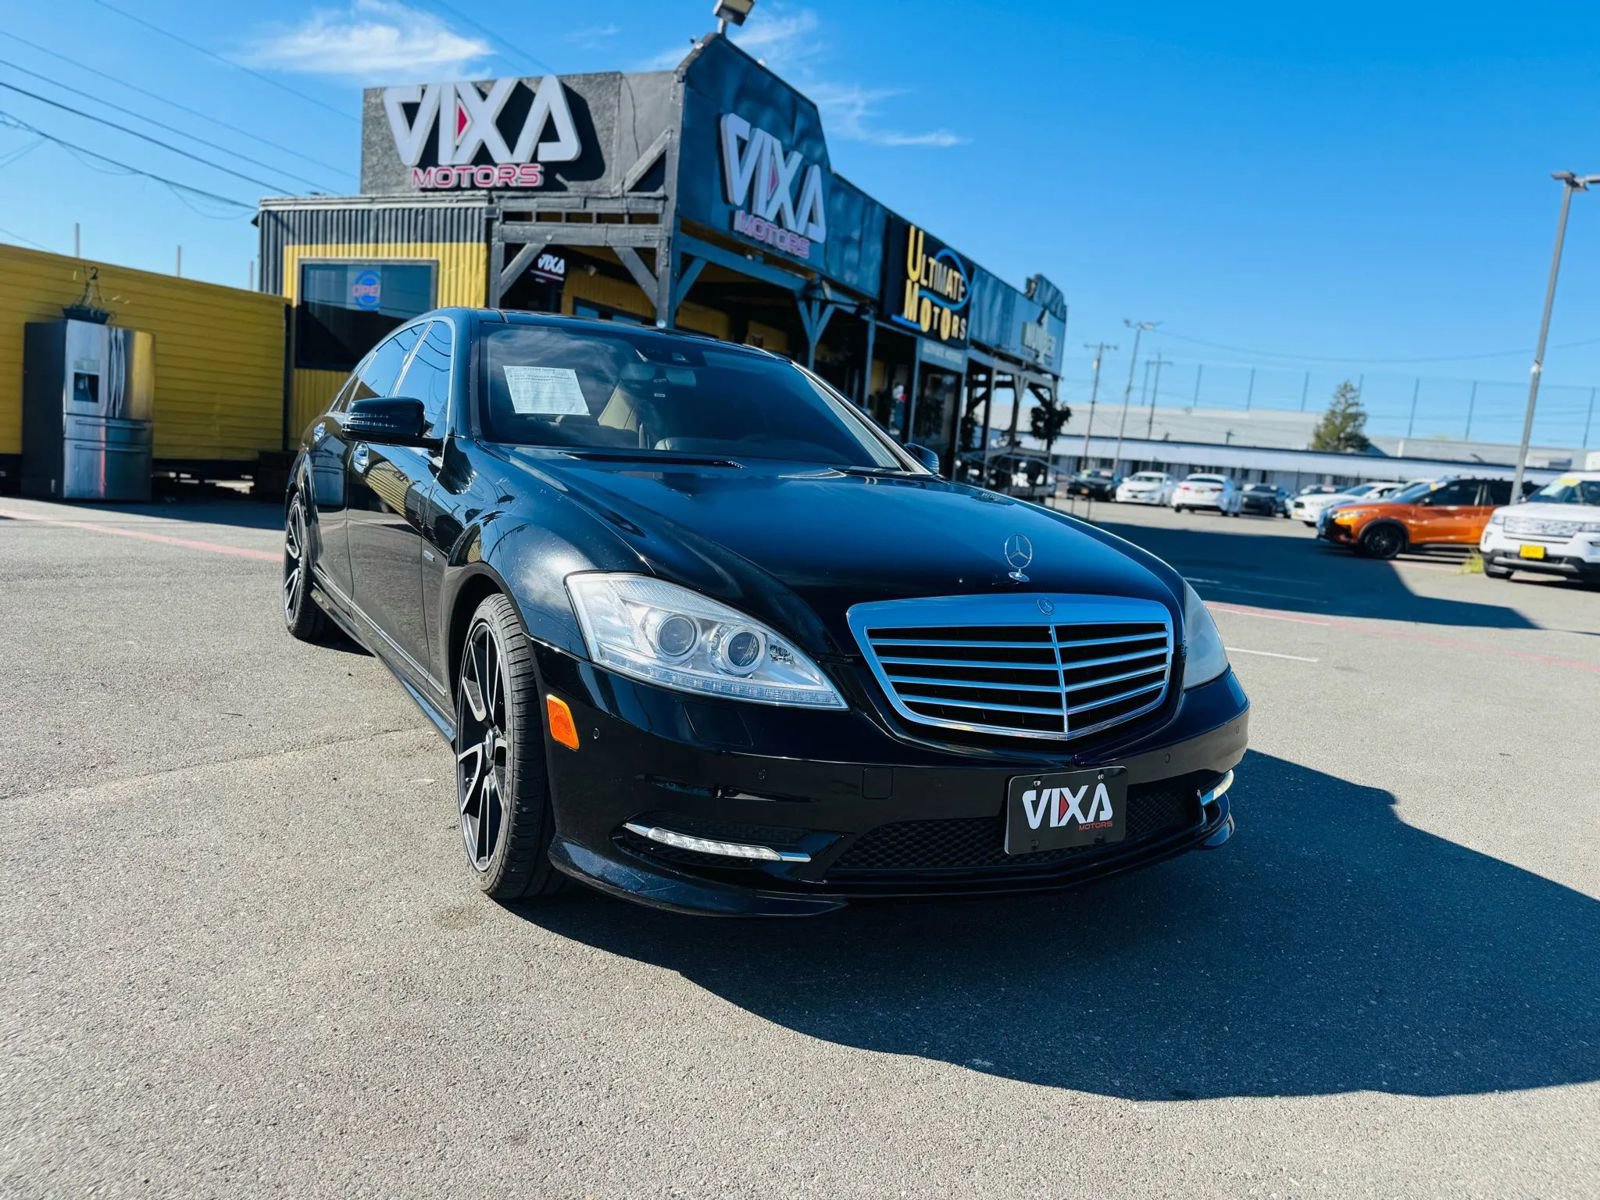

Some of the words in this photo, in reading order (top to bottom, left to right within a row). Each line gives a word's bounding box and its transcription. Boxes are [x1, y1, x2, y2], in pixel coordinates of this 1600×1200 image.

[384, 75, 581, 166] VIXA
[412, 163, 543, 188] MOTORS
[721, 113, 826, 244] VIXA
[734, 210, 810, 259] MOTORS
[538, 253, 565, 275] VIXA
[1022, 782, 1113, 830] VIXA
[1079, 820, 1113, 832] MOTORS
